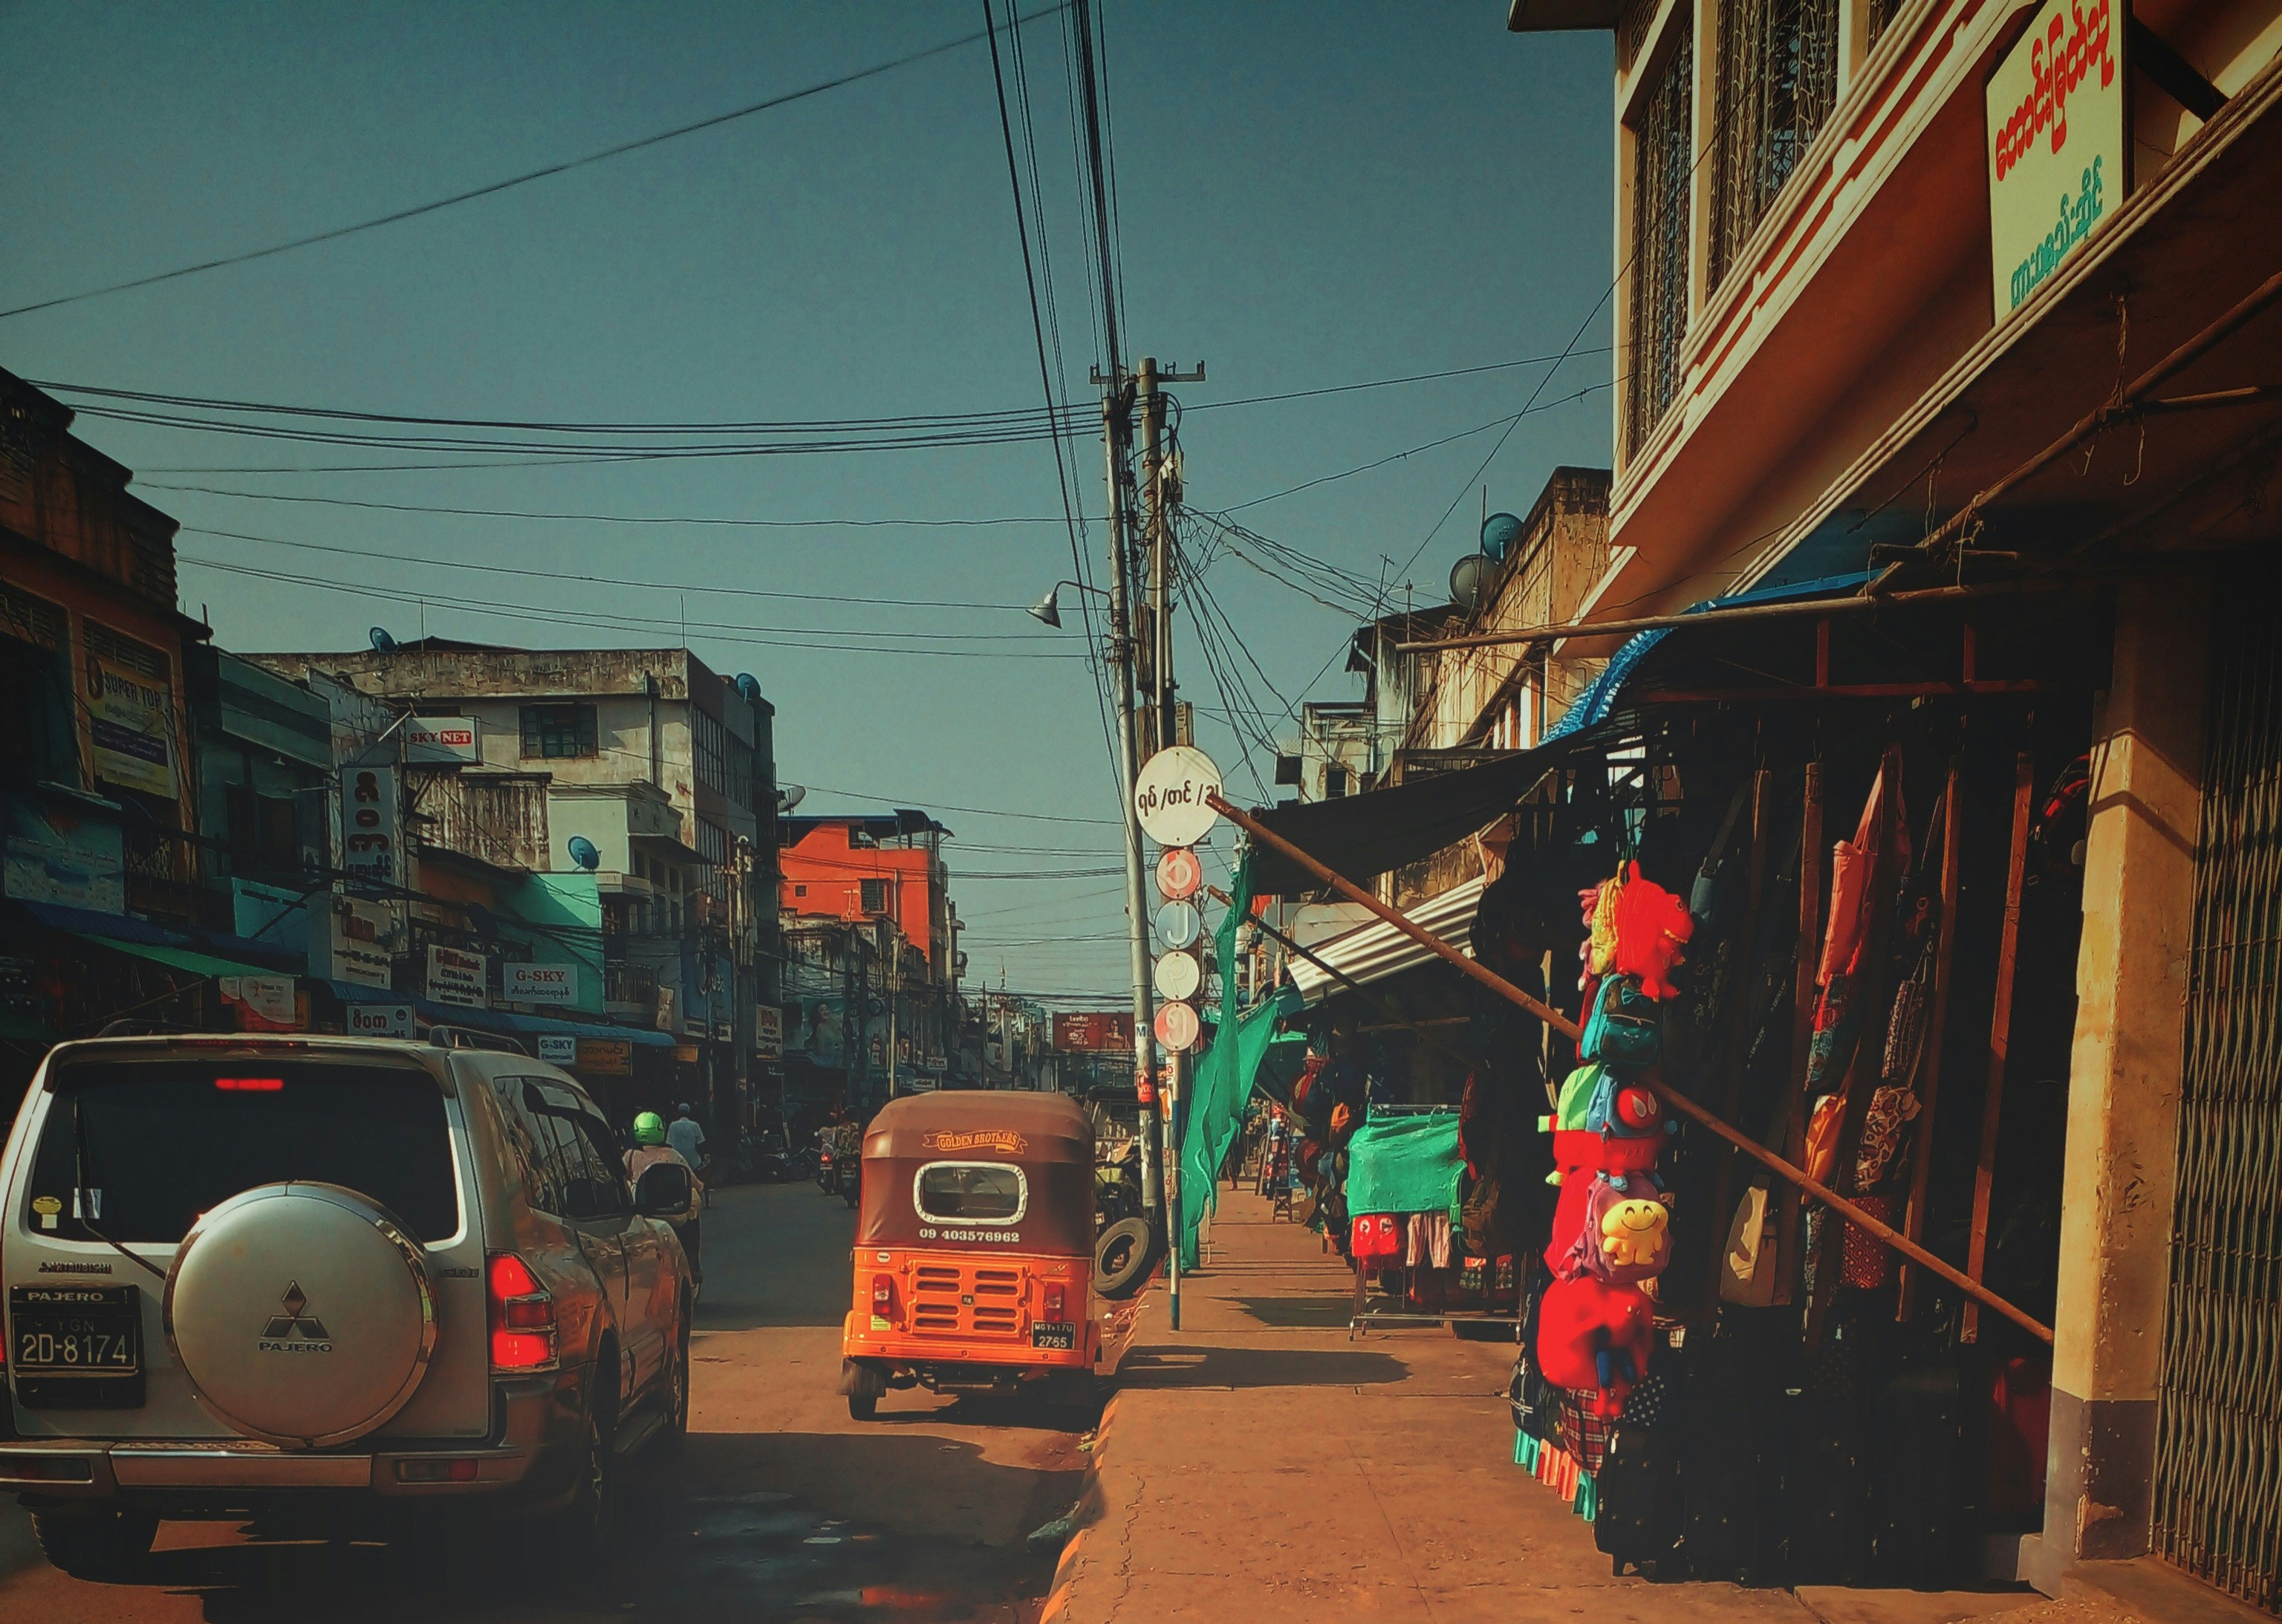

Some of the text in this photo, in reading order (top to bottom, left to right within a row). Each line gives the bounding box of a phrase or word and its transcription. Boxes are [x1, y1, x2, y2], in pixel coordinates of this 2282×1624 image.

[105, 672, 162, 711] SUPER TOP
[409, 732, 471, 744] SKY NET
[515, 969, 566, 983] G-SKY
[539, 1039, 573, 1050] G-SKY
[940, 1131, 1018, 1148] GOLDEN BROTHERS
[919, 1228, 1020, 1243] 09 403576962
[27, 1291, 104, 1302] PAJERO
[57, 1318, 94, 1332] YGN
[259, 1342, 333, 1352] PAJERO
[1038, 1336, 1067, 1348] 2765
[22, 1334, 127, 1365] 2D-8174
